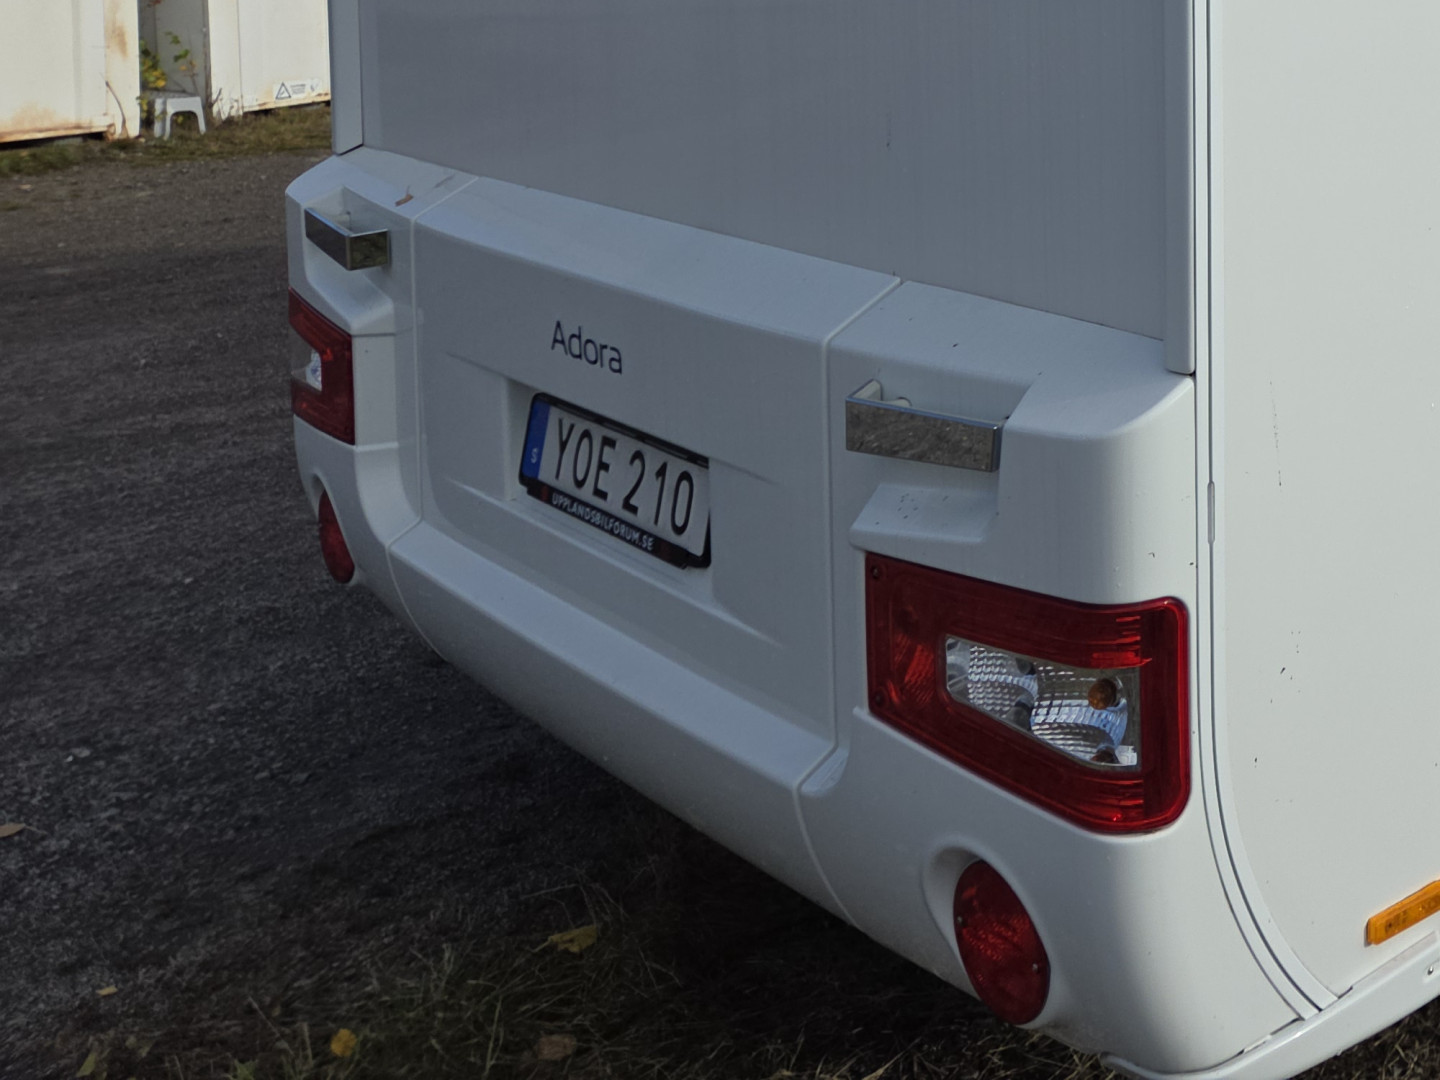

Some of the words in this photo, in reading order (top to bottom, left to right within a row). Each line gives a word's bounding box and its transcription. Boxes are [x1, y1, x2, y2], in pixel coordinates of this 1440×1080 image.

[551, 320, 622, 374] Adora
[530, 447, 538, 464] S
[555, 417, 616, 501] YOE
[622, 449, 694, 536] 210
[551, 492, 654, 551] UPPLANDSBILFORUM.SE
